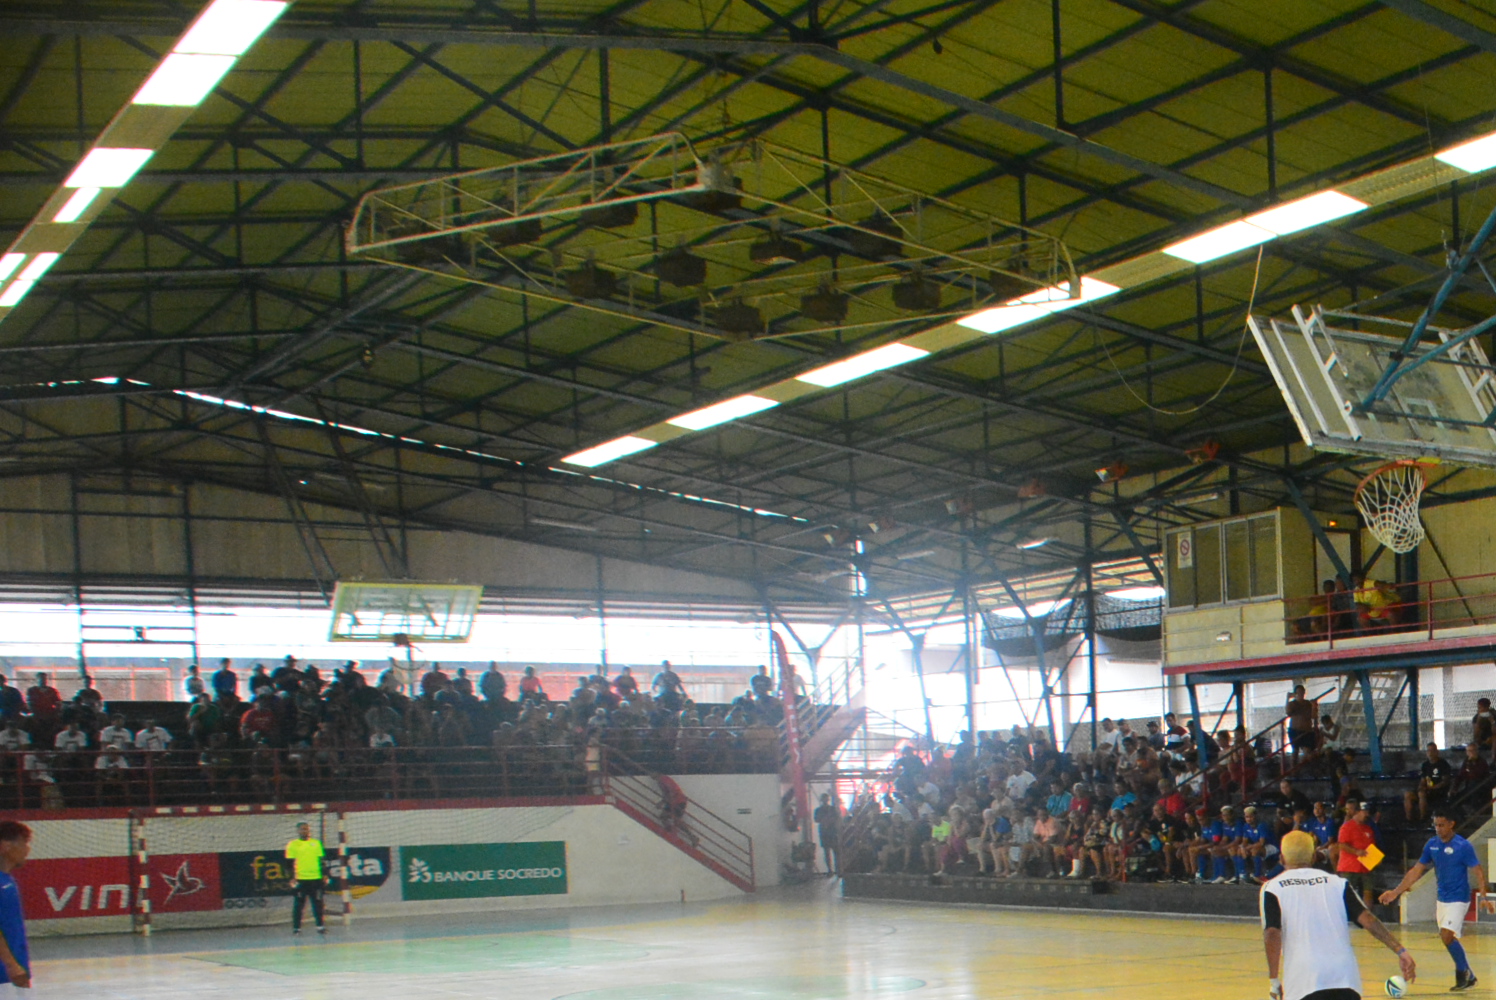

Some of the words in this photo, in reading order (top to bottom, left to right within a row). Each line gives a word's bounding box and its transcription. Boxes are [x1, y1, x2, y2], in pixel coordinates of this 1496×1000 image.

[250, 855, 291, 880] fa
[325, 853, 383, 877] ata
[434, 869, 495, 883] BANQUE
[497, 867, 563, 880] SOCREDO
[1279, 876, 1329, 888] RESPECT
